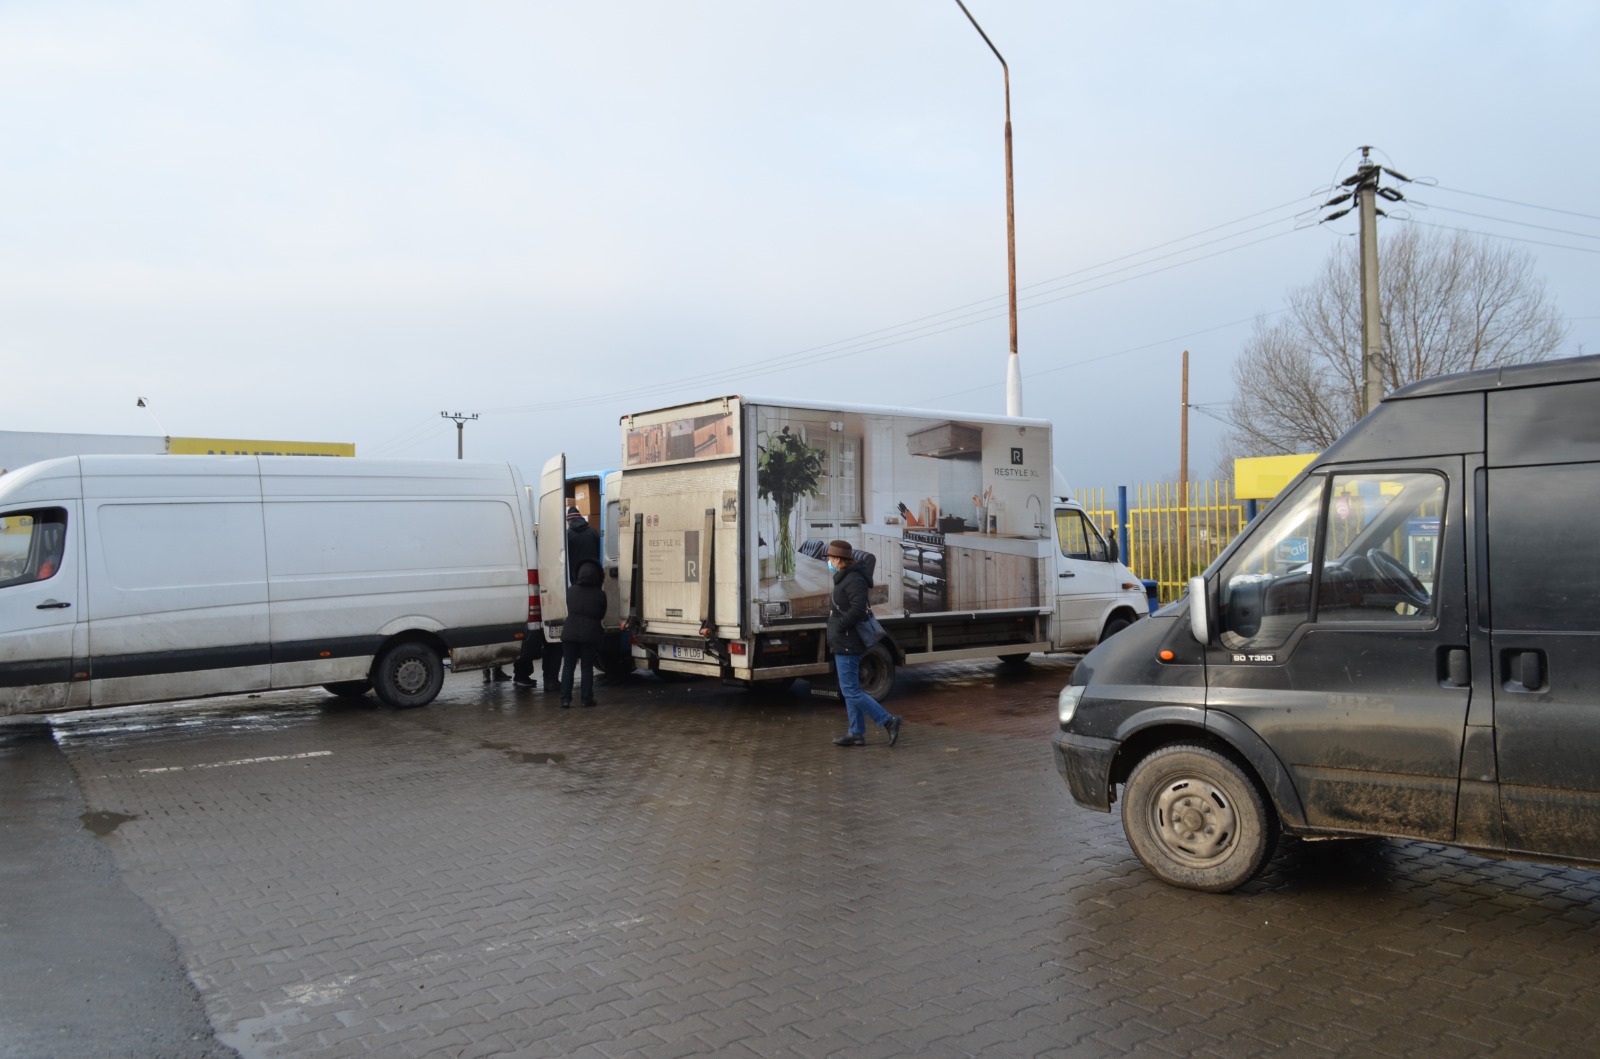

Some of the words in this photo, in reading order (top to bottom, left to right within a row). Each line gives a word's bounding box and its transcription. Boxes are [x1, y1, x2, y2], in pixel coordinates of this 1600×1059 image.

[1013, 450, 1021, 462] R
[994, 467, 1029, 477] RESTYLE
[1030, 469, 1040, 478] XL
[648, 539, 673, 547] RESTYLE
[687, 560, 697, 577] R
